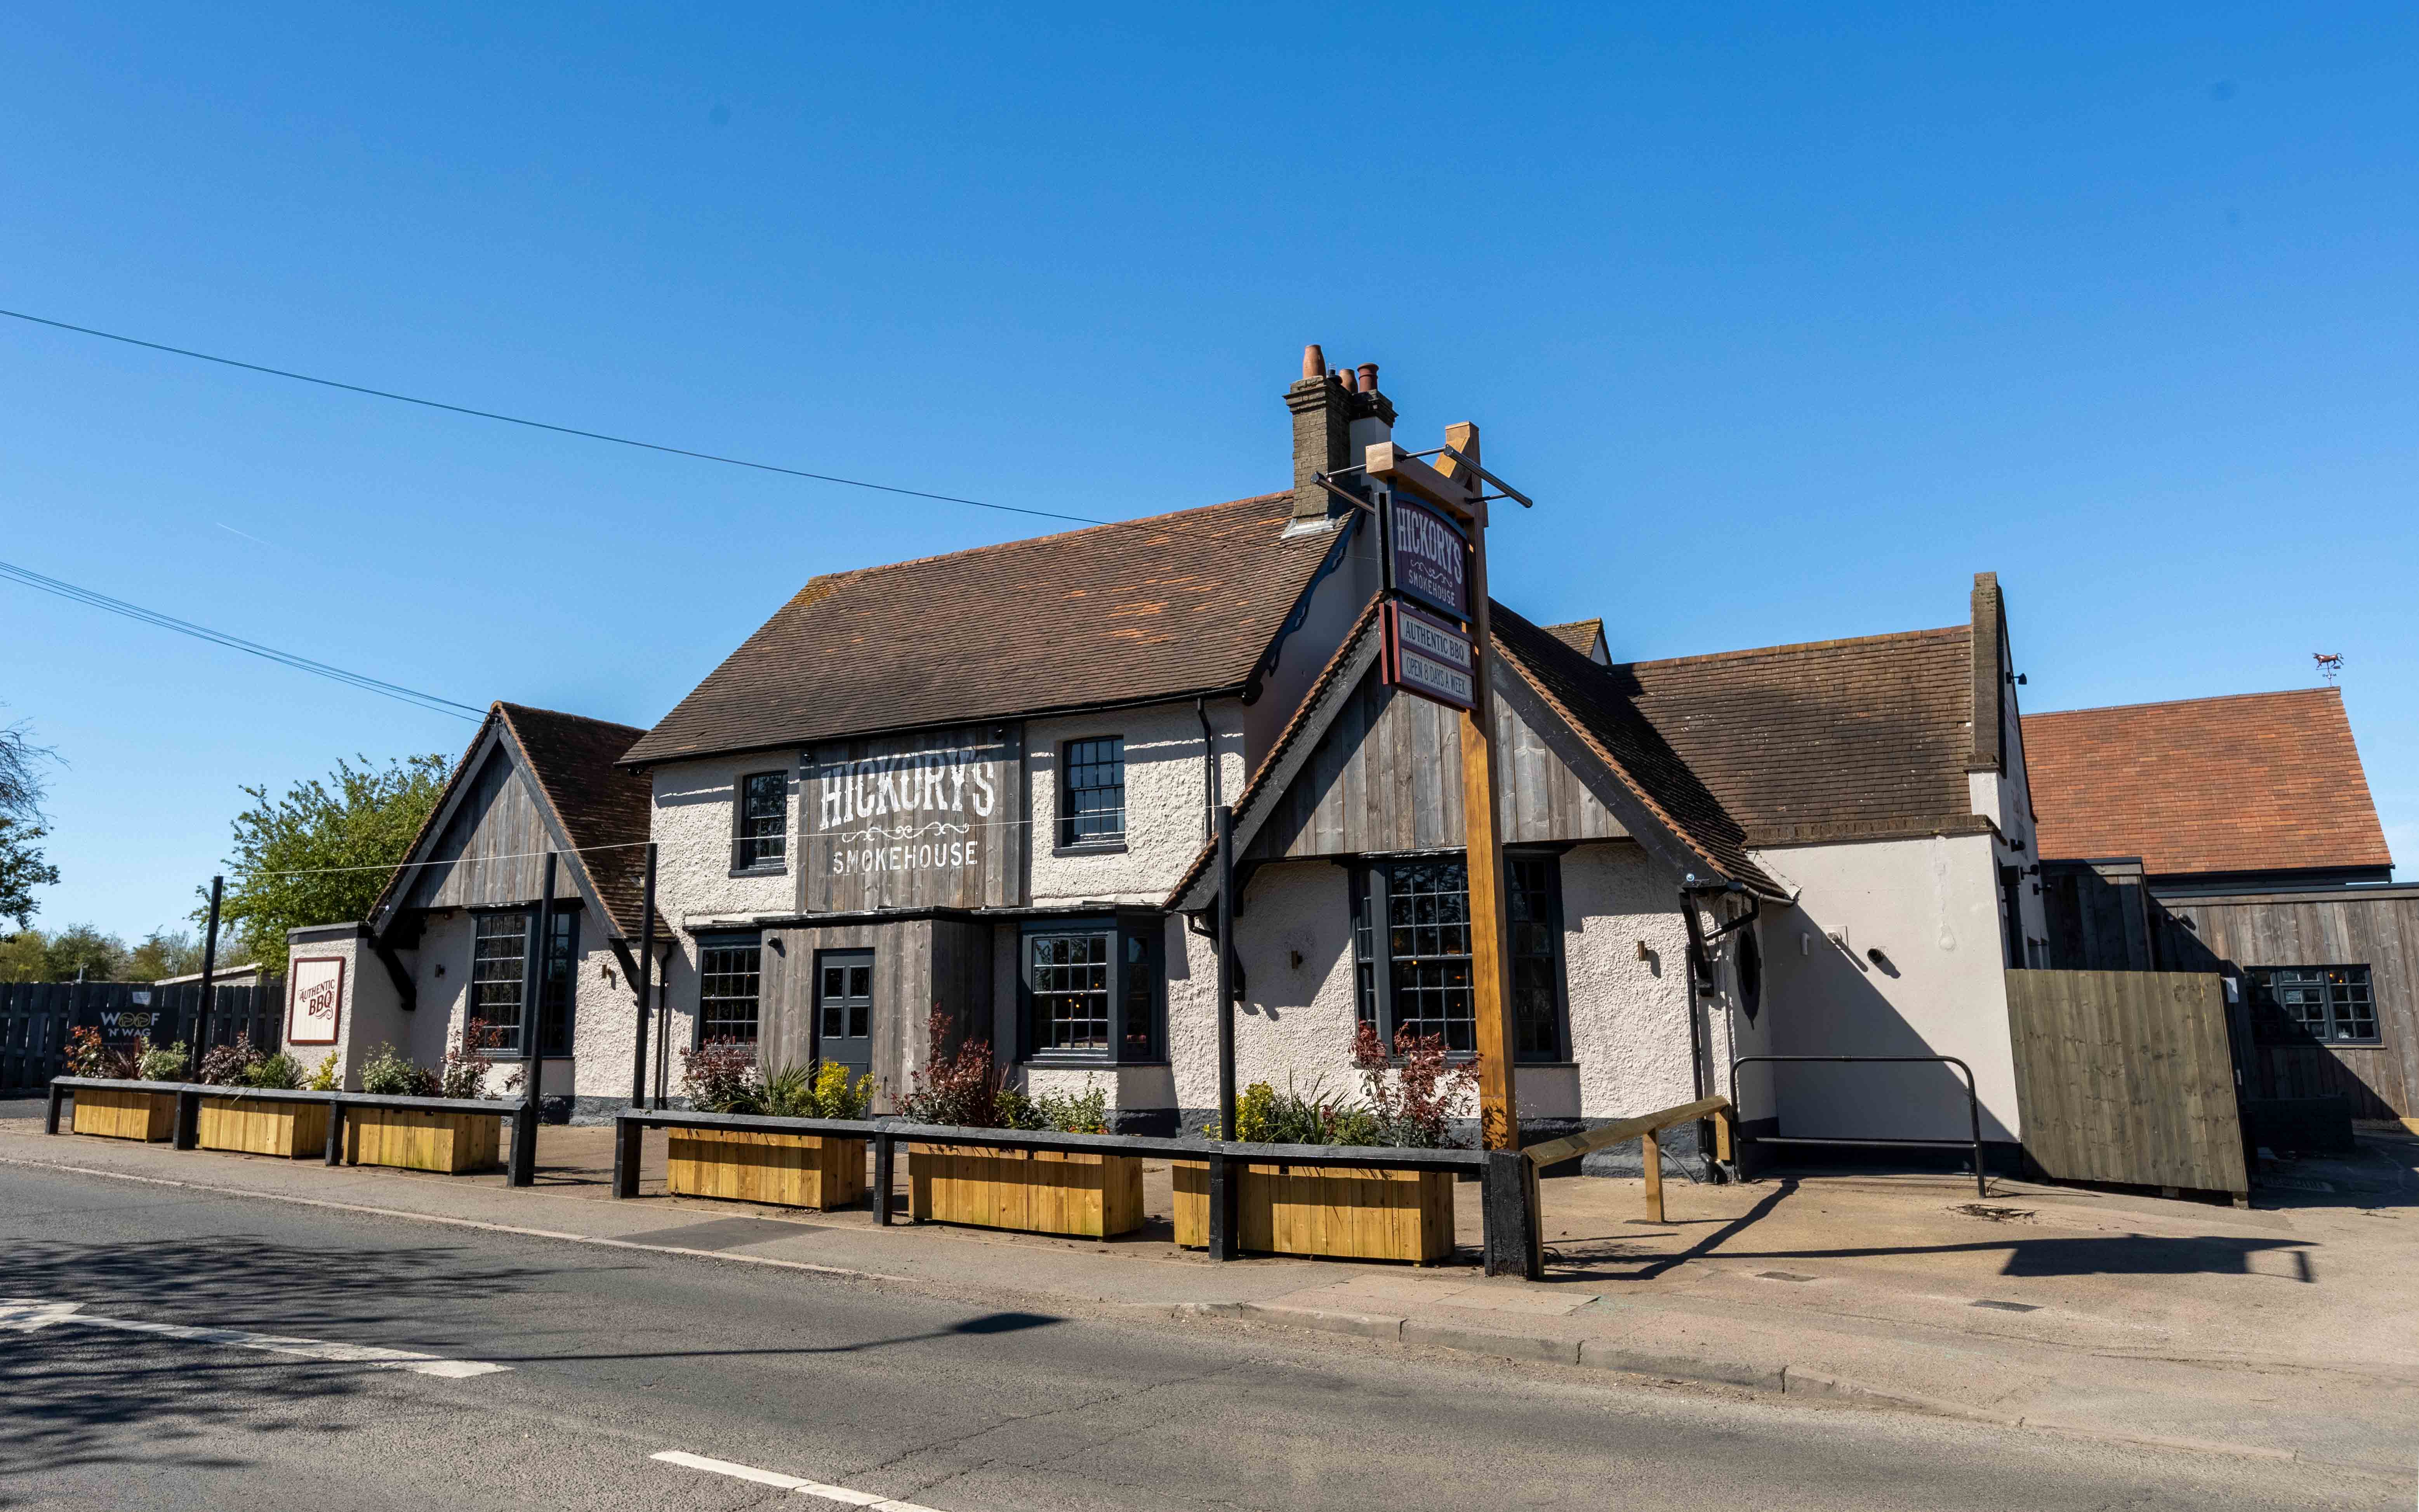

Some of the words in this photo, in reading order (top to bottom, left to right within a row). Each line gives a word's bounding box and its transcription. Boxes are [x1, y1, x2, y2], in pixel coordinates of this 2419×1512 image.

[1396, 507, 1462, 584] HICKORY'S
[1409, 569, 1455, 607] SMOKEHOUSE
[1406, 621, 1448, 654] AUTHENTIC
[1449, 641, 1464, 662] BBQ
[1407, 657, 1423, 678] OPEN
[1424, 664, 1428, 680] 8
[1430, 667, 1444, 687] DAYS
[1446, 672, 1450, 689] A
[1451, 674, 1467, 695] WEEK
[833, 841, 978, 874] SMOKEHOUSE
[299, 979, 335, 1002] AUTHENTIC
[308, 990, 332, 1016] BBQ
[100, 1012, 160, 1027] WOOF
[121, 1028, 151, 1037] WAG
